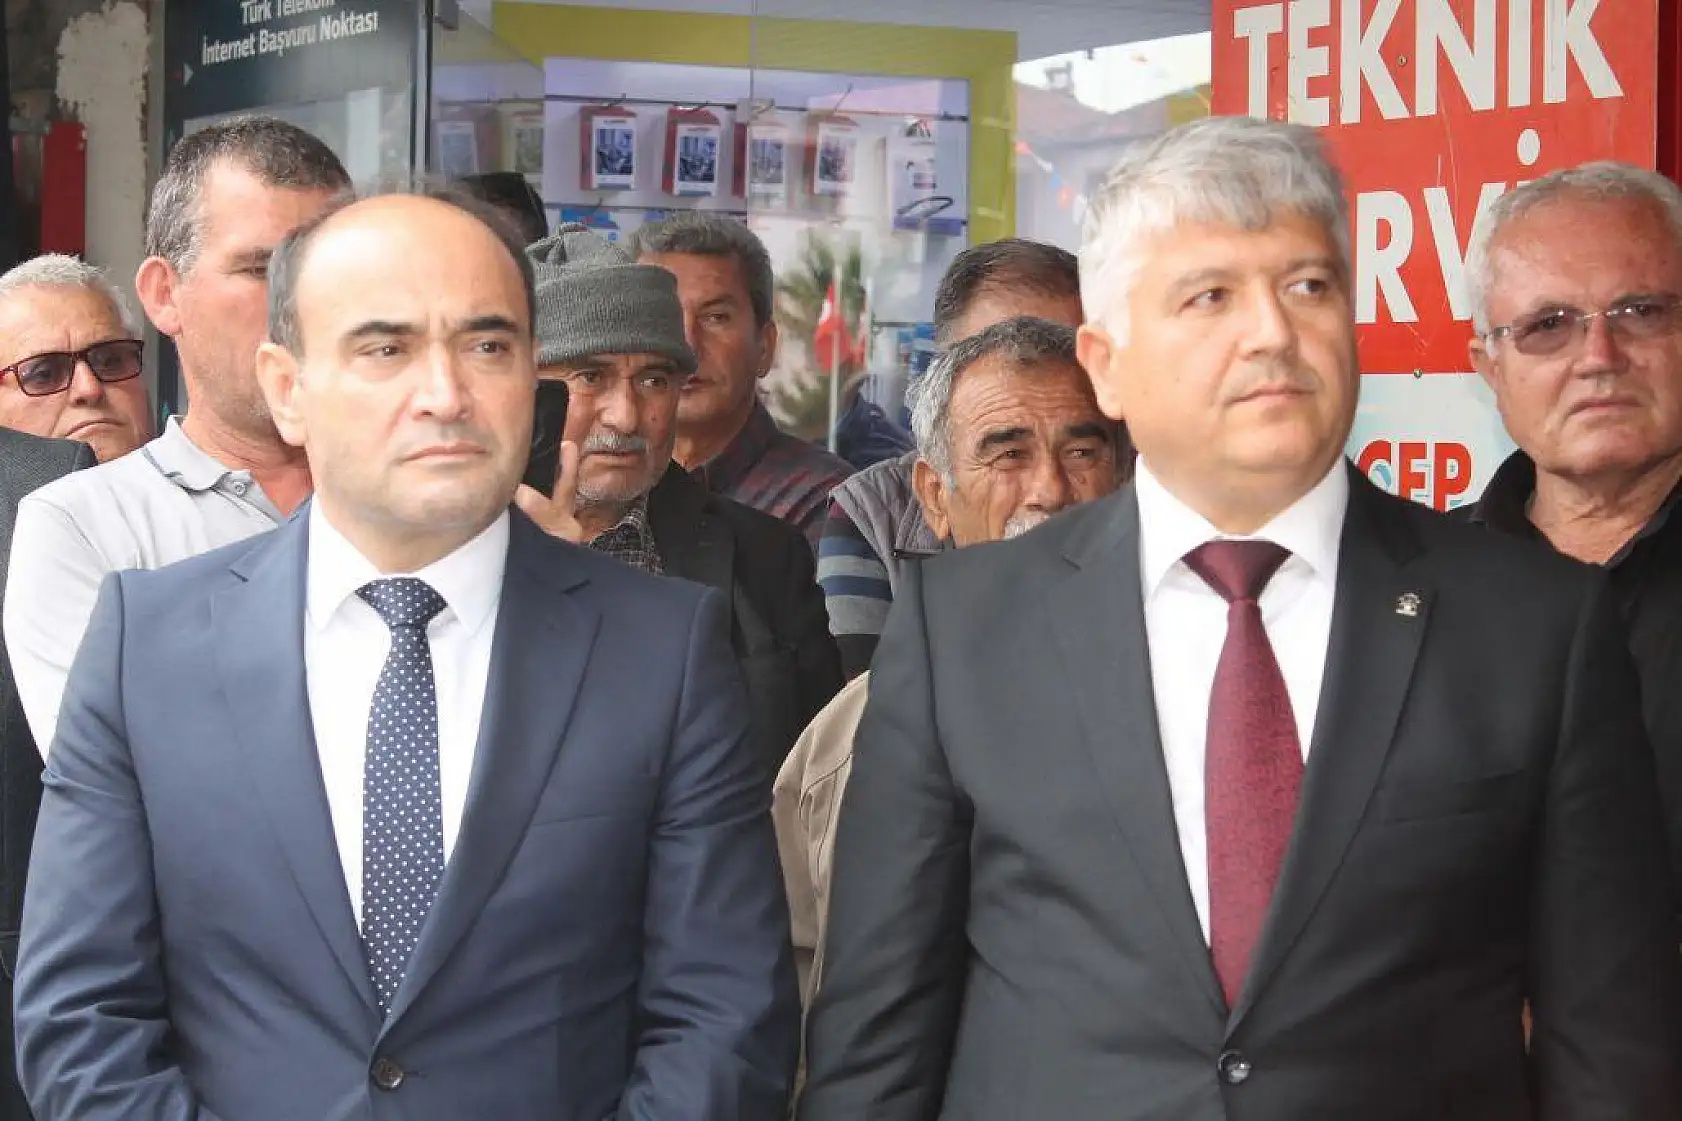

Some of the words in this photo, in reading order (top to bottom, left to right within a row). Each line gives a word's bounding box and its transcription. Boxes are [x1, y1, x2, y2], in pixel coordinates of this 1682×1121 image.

[241, 0, 272, 25] Türk
[259, 28, 317, 57] Başvuru
[319, 11, 378, 41] Noktası
